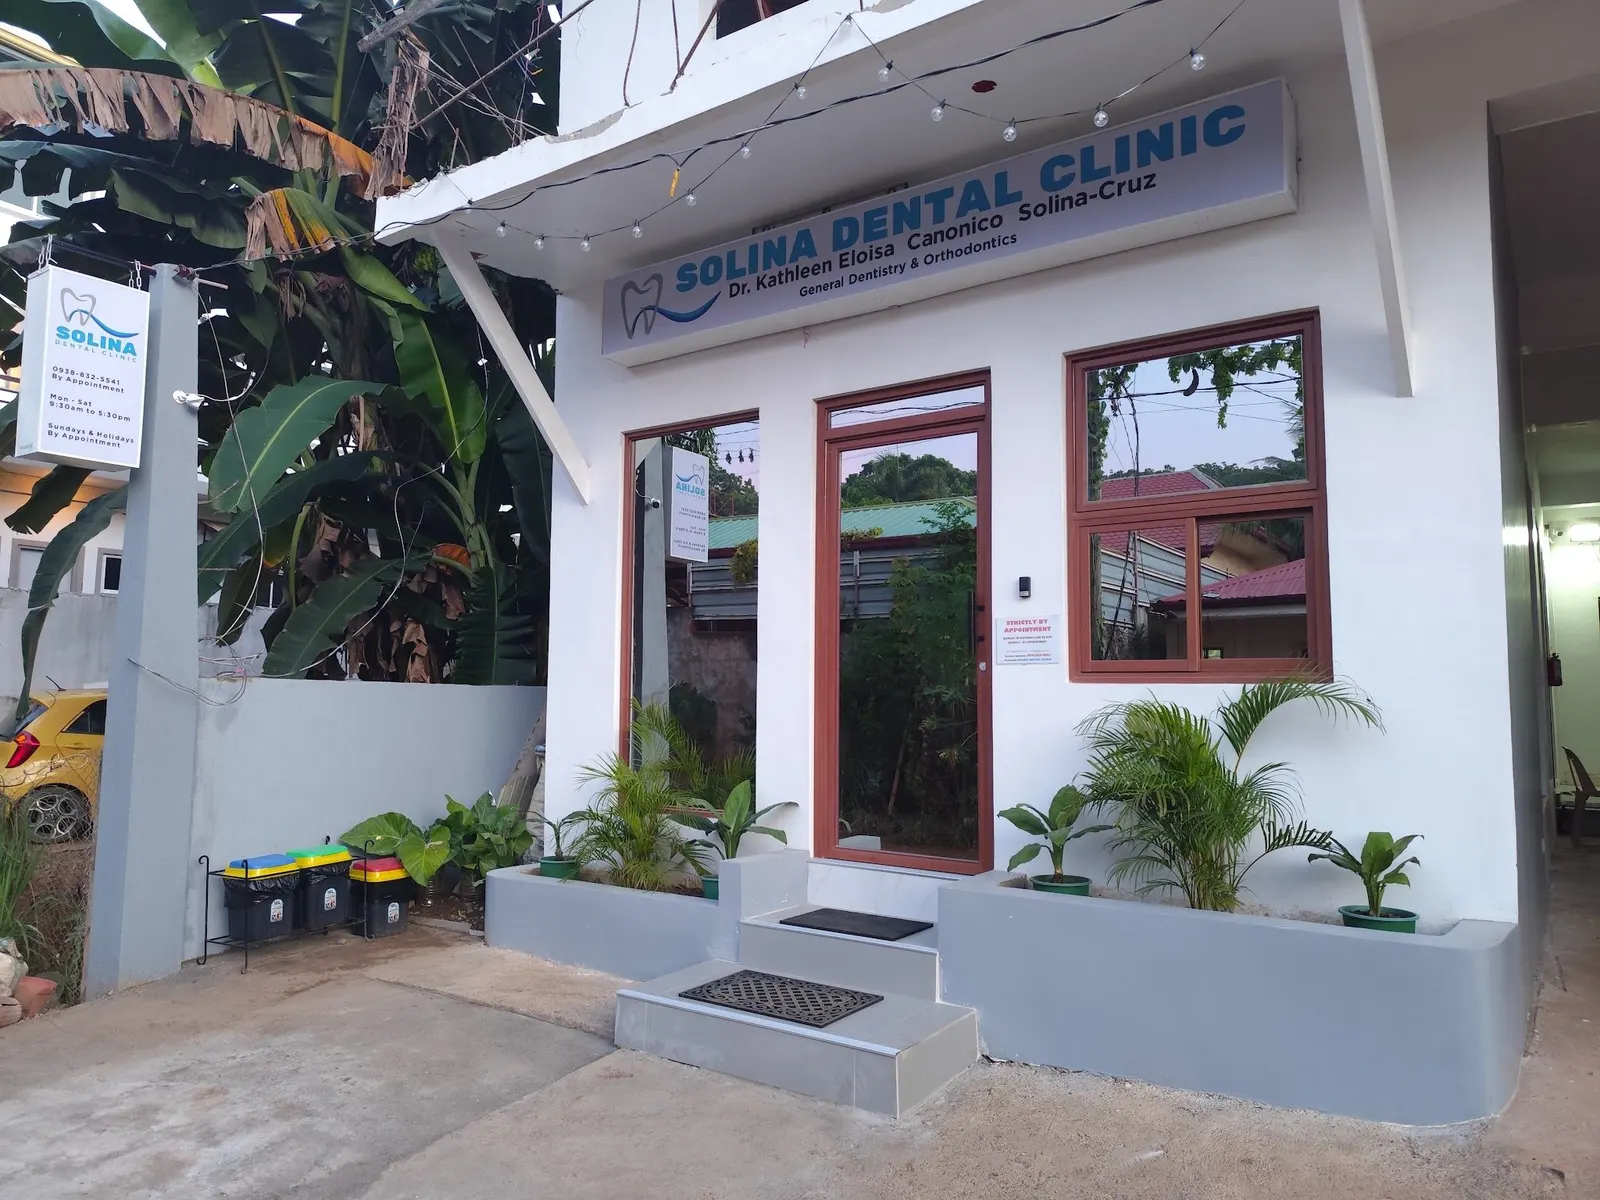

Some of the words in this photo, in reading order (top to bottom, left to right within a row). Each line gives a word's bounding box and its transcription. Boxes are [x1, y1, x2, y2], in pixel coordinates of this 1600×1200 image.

[676, 228, 818, 293] SOLINA
[832, 170, 1023, 252] DENTAL
[1040, 104, 1246, 193] CLINIC
[729, 282, 751, 298] Dr.
[756, 260, 832, 291] Kathleen
[839, 243, 895, 269] Eloisa
[907, 214, 1003, 250] Canonico
[1018, 173, 1156, 221] Solina-Cruz
[800, 276, 844, 297] General
[849, 261, 906, 285] Dentistry
[910, 257, 919, 269] &
[923, 233, 1018, 265] Orthodontics
[55, 339, 96, 354] DENTAL
[101, 350, 137, 363] CLINIC
[56, 325, 137, 357] SOLINA
[52, 365, 120, 385] 0938-832-5541
[52, 373, 63, 381] By
[65, 376, 124, 394] Appointment
[49, 400, 83, 412] 9:30am
[98, 410, 131, 422] 5:30pm
[50, 393, 69, 402] Mon
[77, 399, 92, 407] Sat
[47, 429, 59, 438] By
[61, 432, 121, 448] Appointment
[48, 422, 86, 434] Sundays
[96, 431, 134, 444] Holidays
